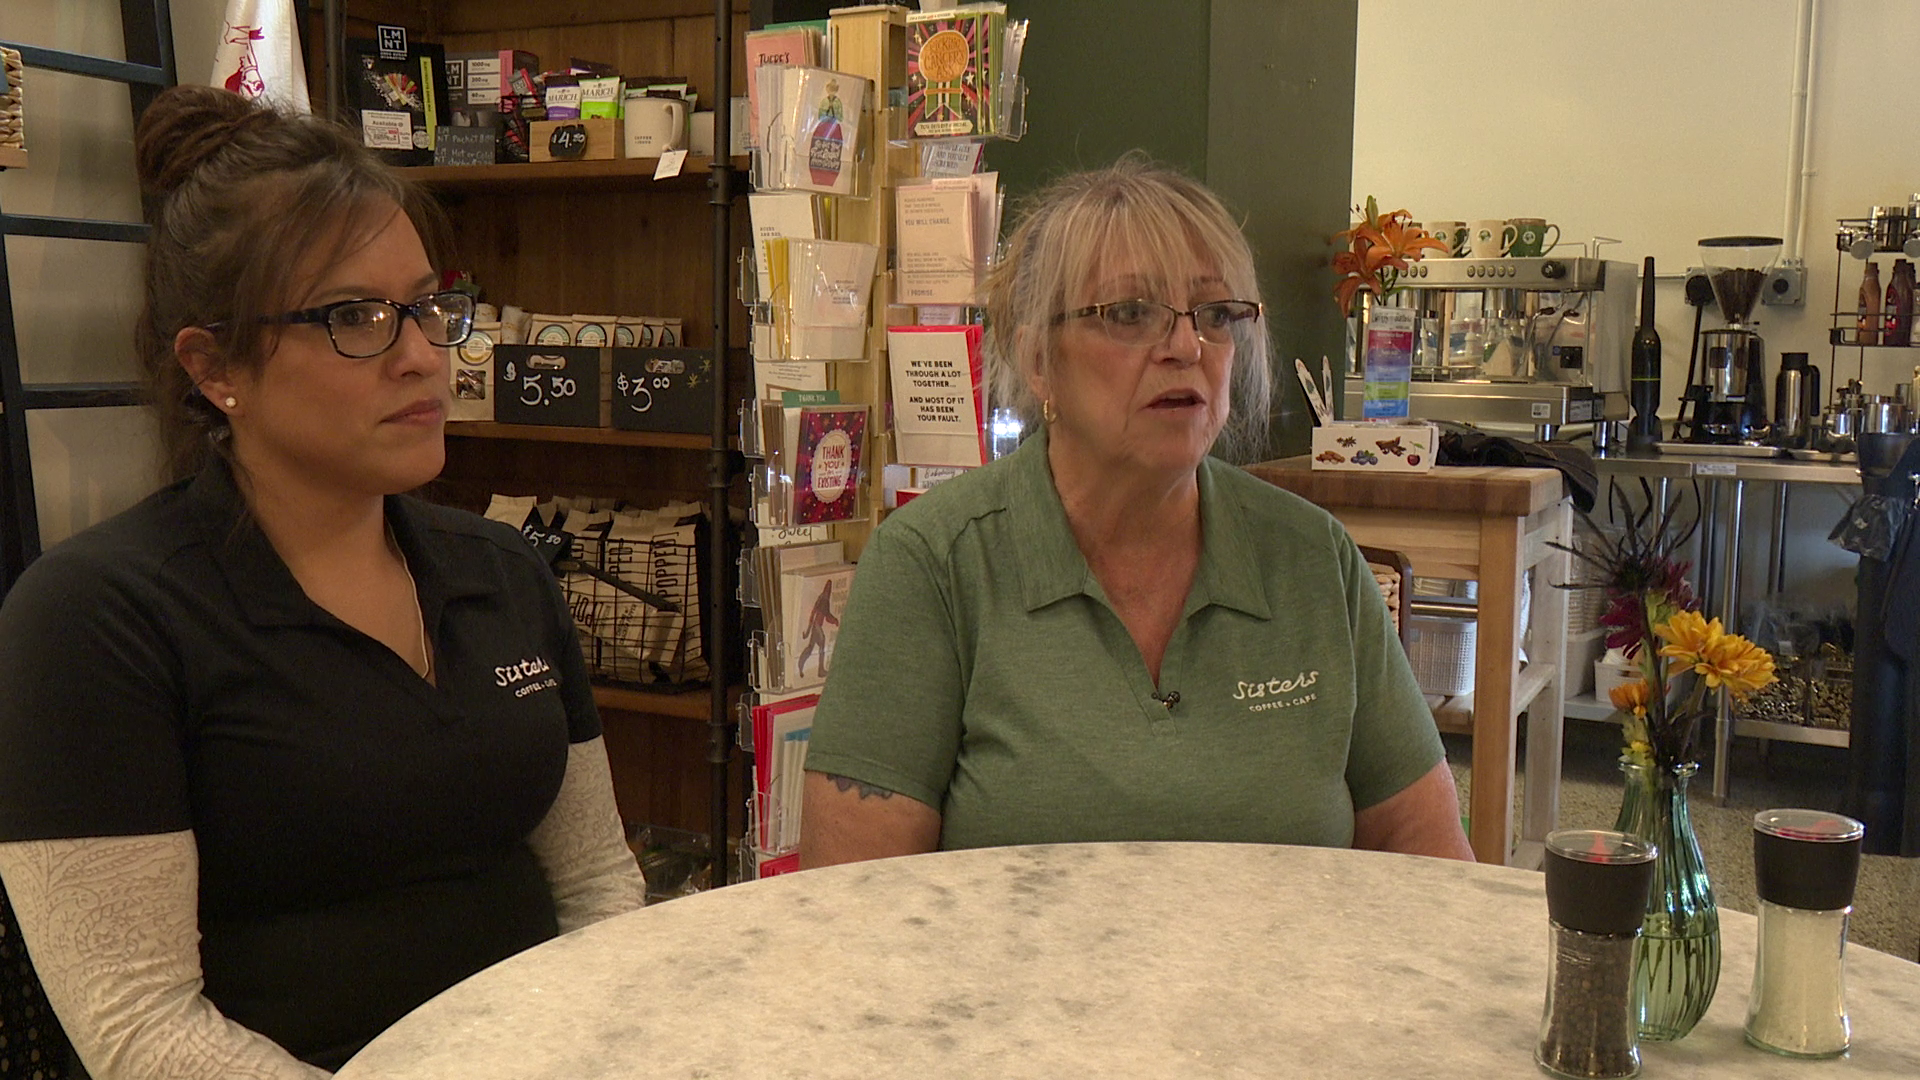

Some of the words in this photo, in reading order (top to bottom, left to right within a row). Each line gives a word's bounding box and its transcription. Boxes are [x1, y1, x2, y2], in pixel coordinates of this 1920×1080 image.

[383, 29, 401, 39] LM
[384, 39, 402, 49] NT
[581, 87, 616, 97] MARICH
[915, 218, 928, 226] WILL
[910, 360, 933, 368] WE'VE
[934, 360, 953, 368] BEEN
[905, 370, 940, 378] THROUGH
[940, 370, 947, 378] A
[947, 370, 961, 378] LOT
[909, 396, 924, 404] AND
[924, 396, 945, 405] MOST
[946, 396, 956, 405] OF
[957, 397, 965, 405] IT
[920, 405, 935, 413] HAS
[935, 405, 955, 413] BEEN
[917, 414, 937, 422] YOUR
[822, 444, 846, 460] THANK
[823, 460, 840, 472] YOU
[817, 475, 842, 489] EXISTING
[1232, 670, 1320, 701] Sisters
[1248, 700, 1284, 713] COFFEE
[1292, 692, 1318, 706] CAFE
